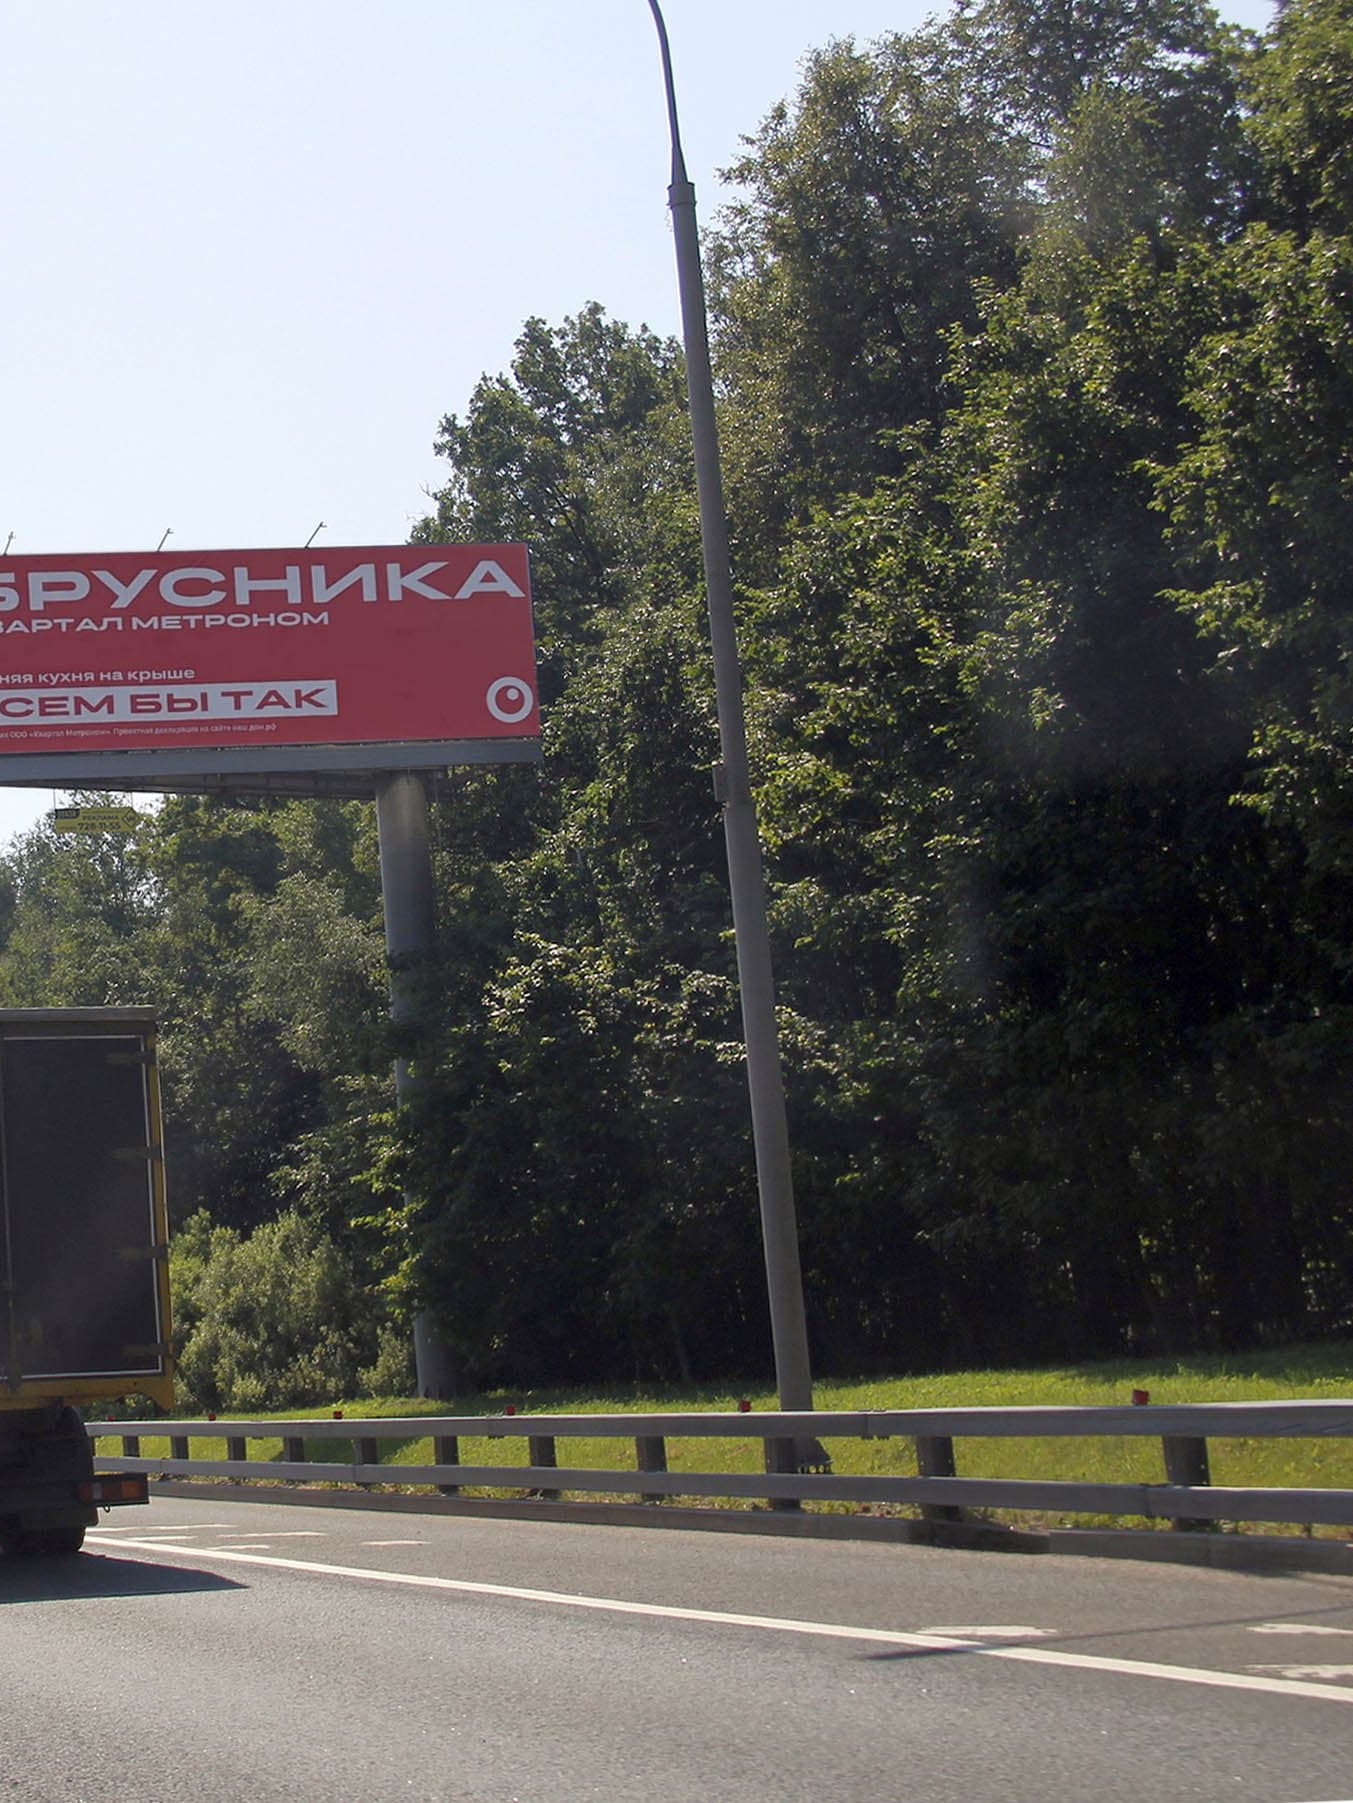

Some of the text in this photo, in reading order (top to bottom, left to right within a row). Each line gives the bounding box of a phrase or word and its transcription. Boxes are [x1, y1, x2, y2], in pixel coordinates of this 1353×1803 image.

[132, 611, 329, 630] МЕТРОНОМ
[38, 672, 95, 685] кухня
[99, 671, 124, 681] на
[127, 669, 195, 683] крыше
[129, 691, 209, 714] БЫ
[220, 688, 329, 711] ТАК
[10, 730, 28, 739] ООО
